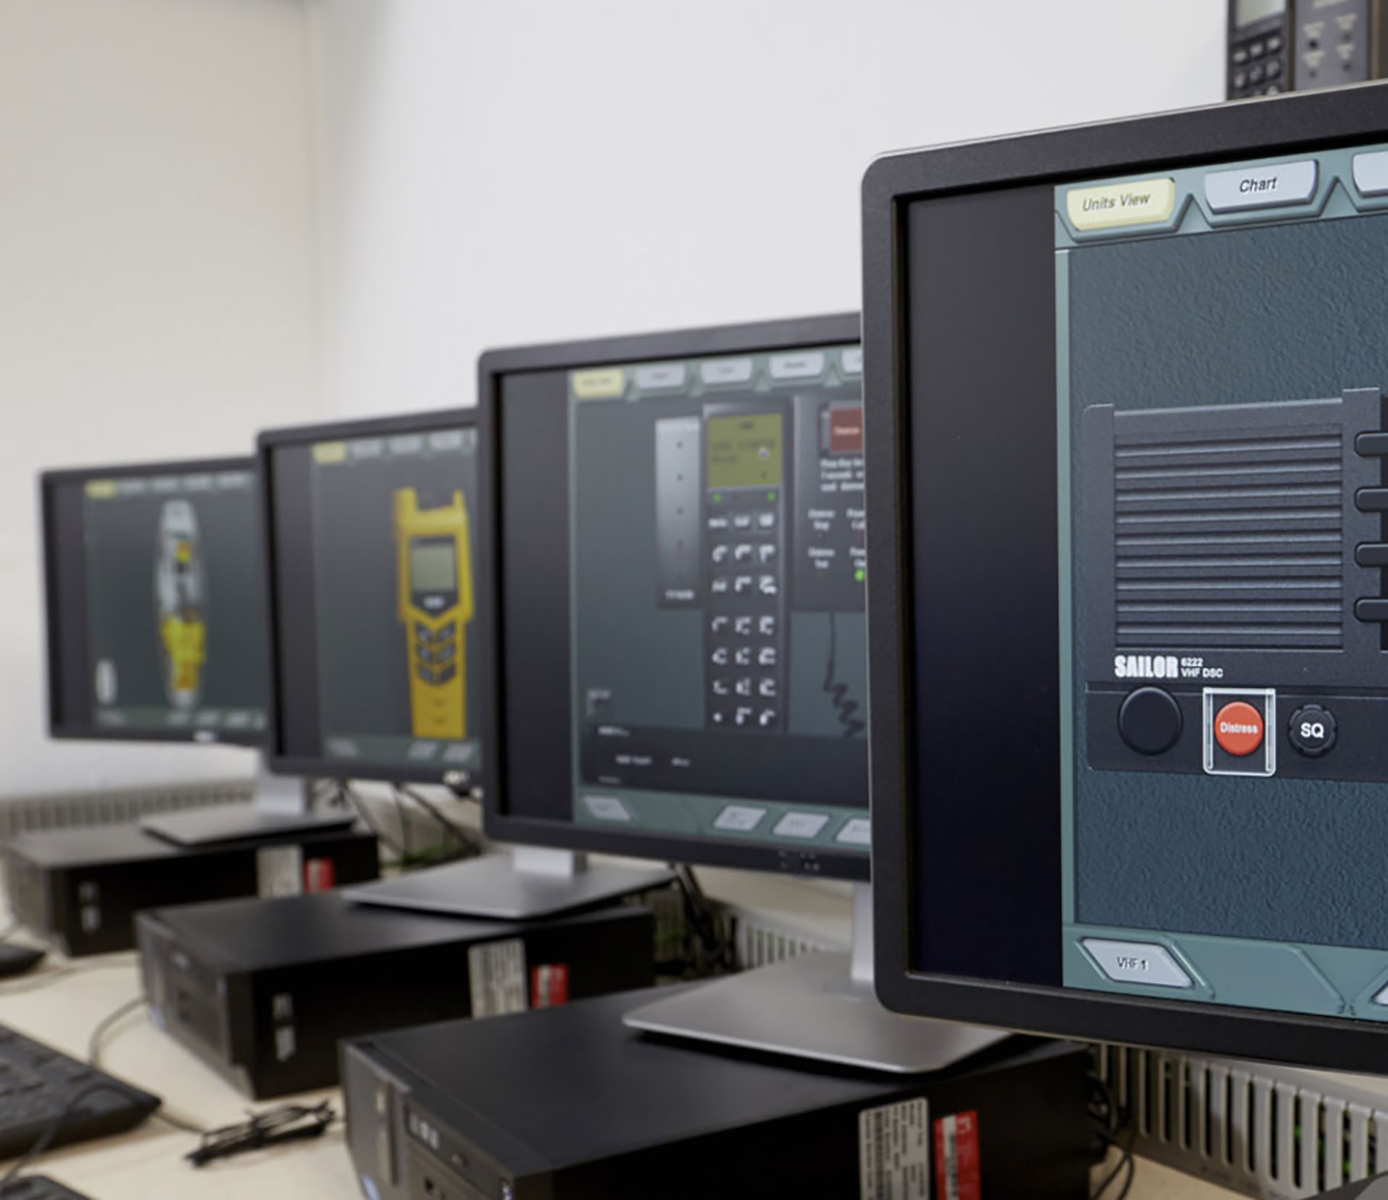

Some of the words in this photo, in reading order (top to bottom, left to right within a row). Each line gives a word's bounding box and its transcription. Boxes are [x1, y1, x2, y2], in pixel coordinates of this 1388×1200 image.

[1239, 174, 1278, 194] Chart
[1082, 193, 1114, 212] Units
[1117, 192, 1150, 209] View
[1114, 655, 1178, 678] SAILOR
[1181, 667, 1201, 678] VHF
[1202, 668, 1223, 678] DSC
[1219, 722, 1258, 734] Distress
[1300, 722, 1325, 739] SQ
